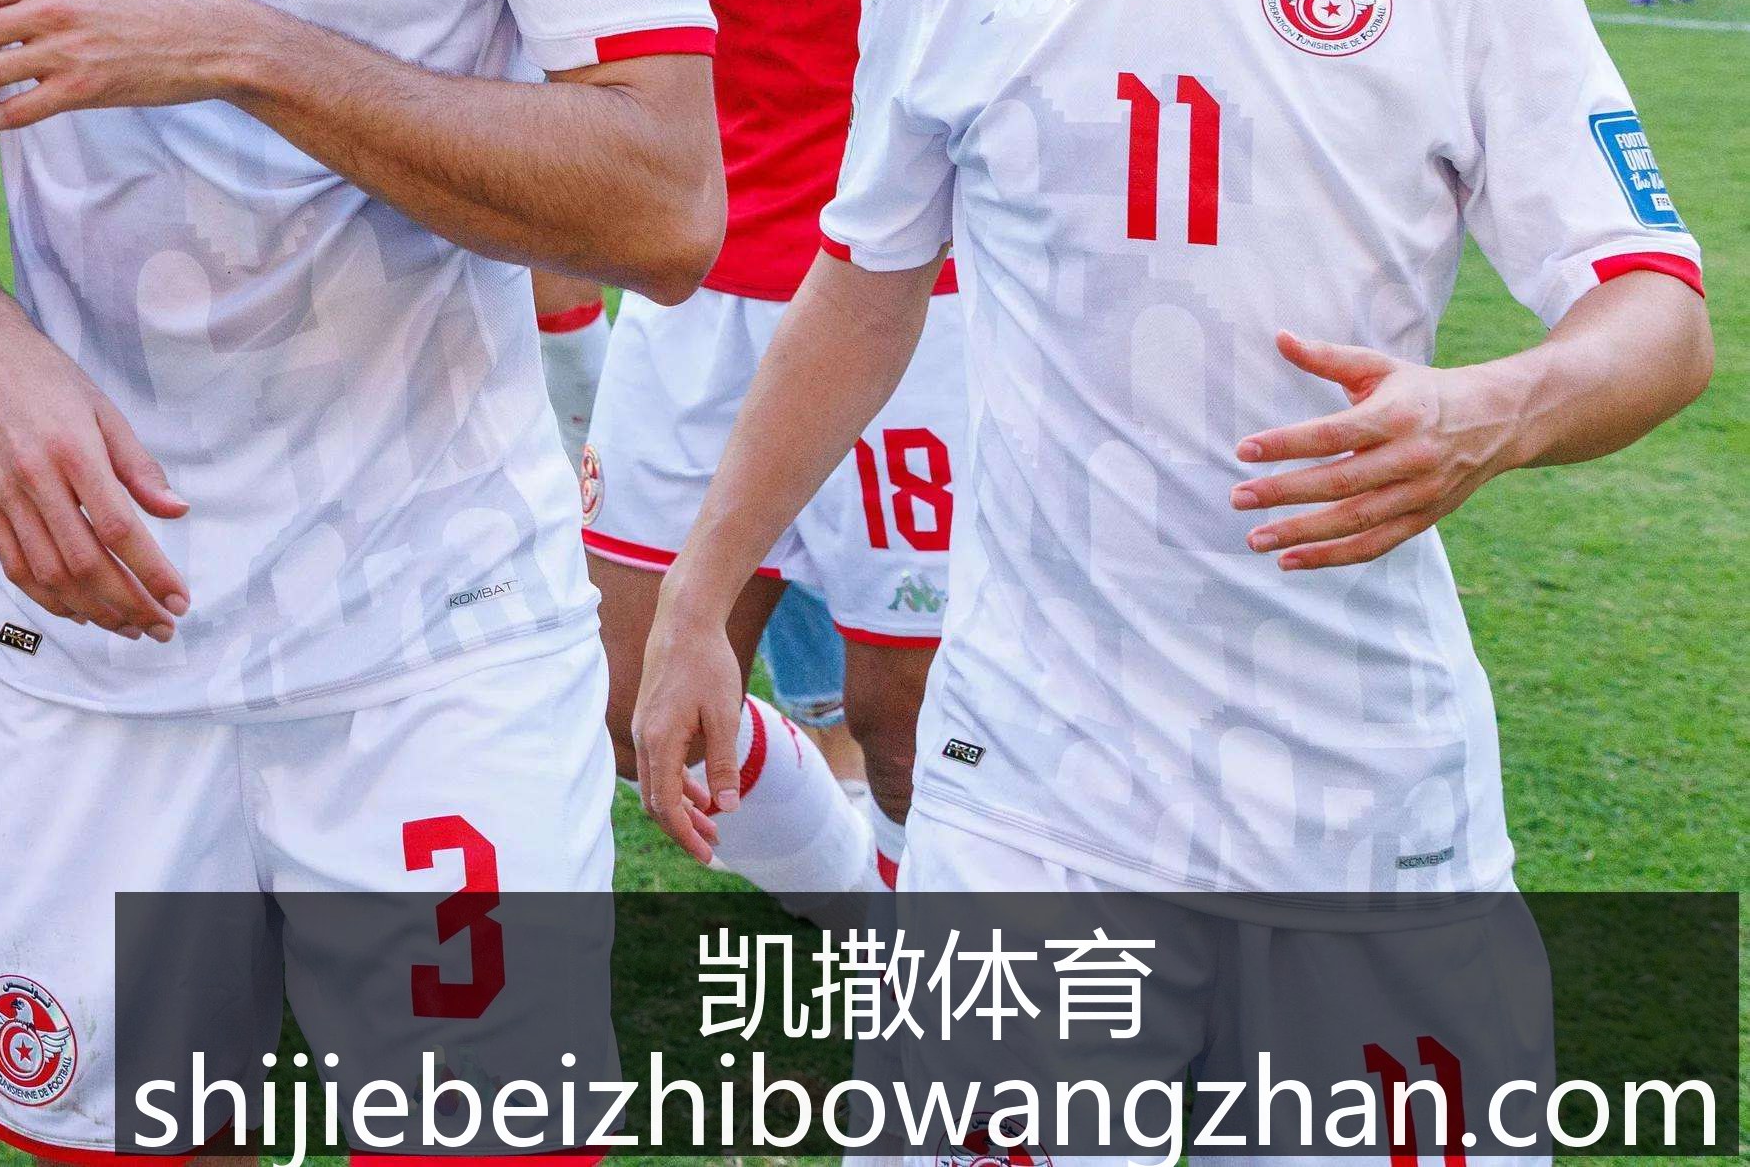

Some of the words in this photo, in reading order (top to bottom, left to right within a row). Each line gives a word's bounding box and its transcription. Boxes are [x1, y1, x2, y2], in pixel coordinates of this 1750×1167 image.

[1350, 38, 1362, 48] DE
[1117, 72, 1220, 246] 11
[854, 428, 954, 551] 18
[450, 581, 513, 607] KOMBAT
[402, 815, 506, 1019] 3
[39, 1088, 49, 1099] DE
[48, 1057, 71, 1093] FOOTBALL
